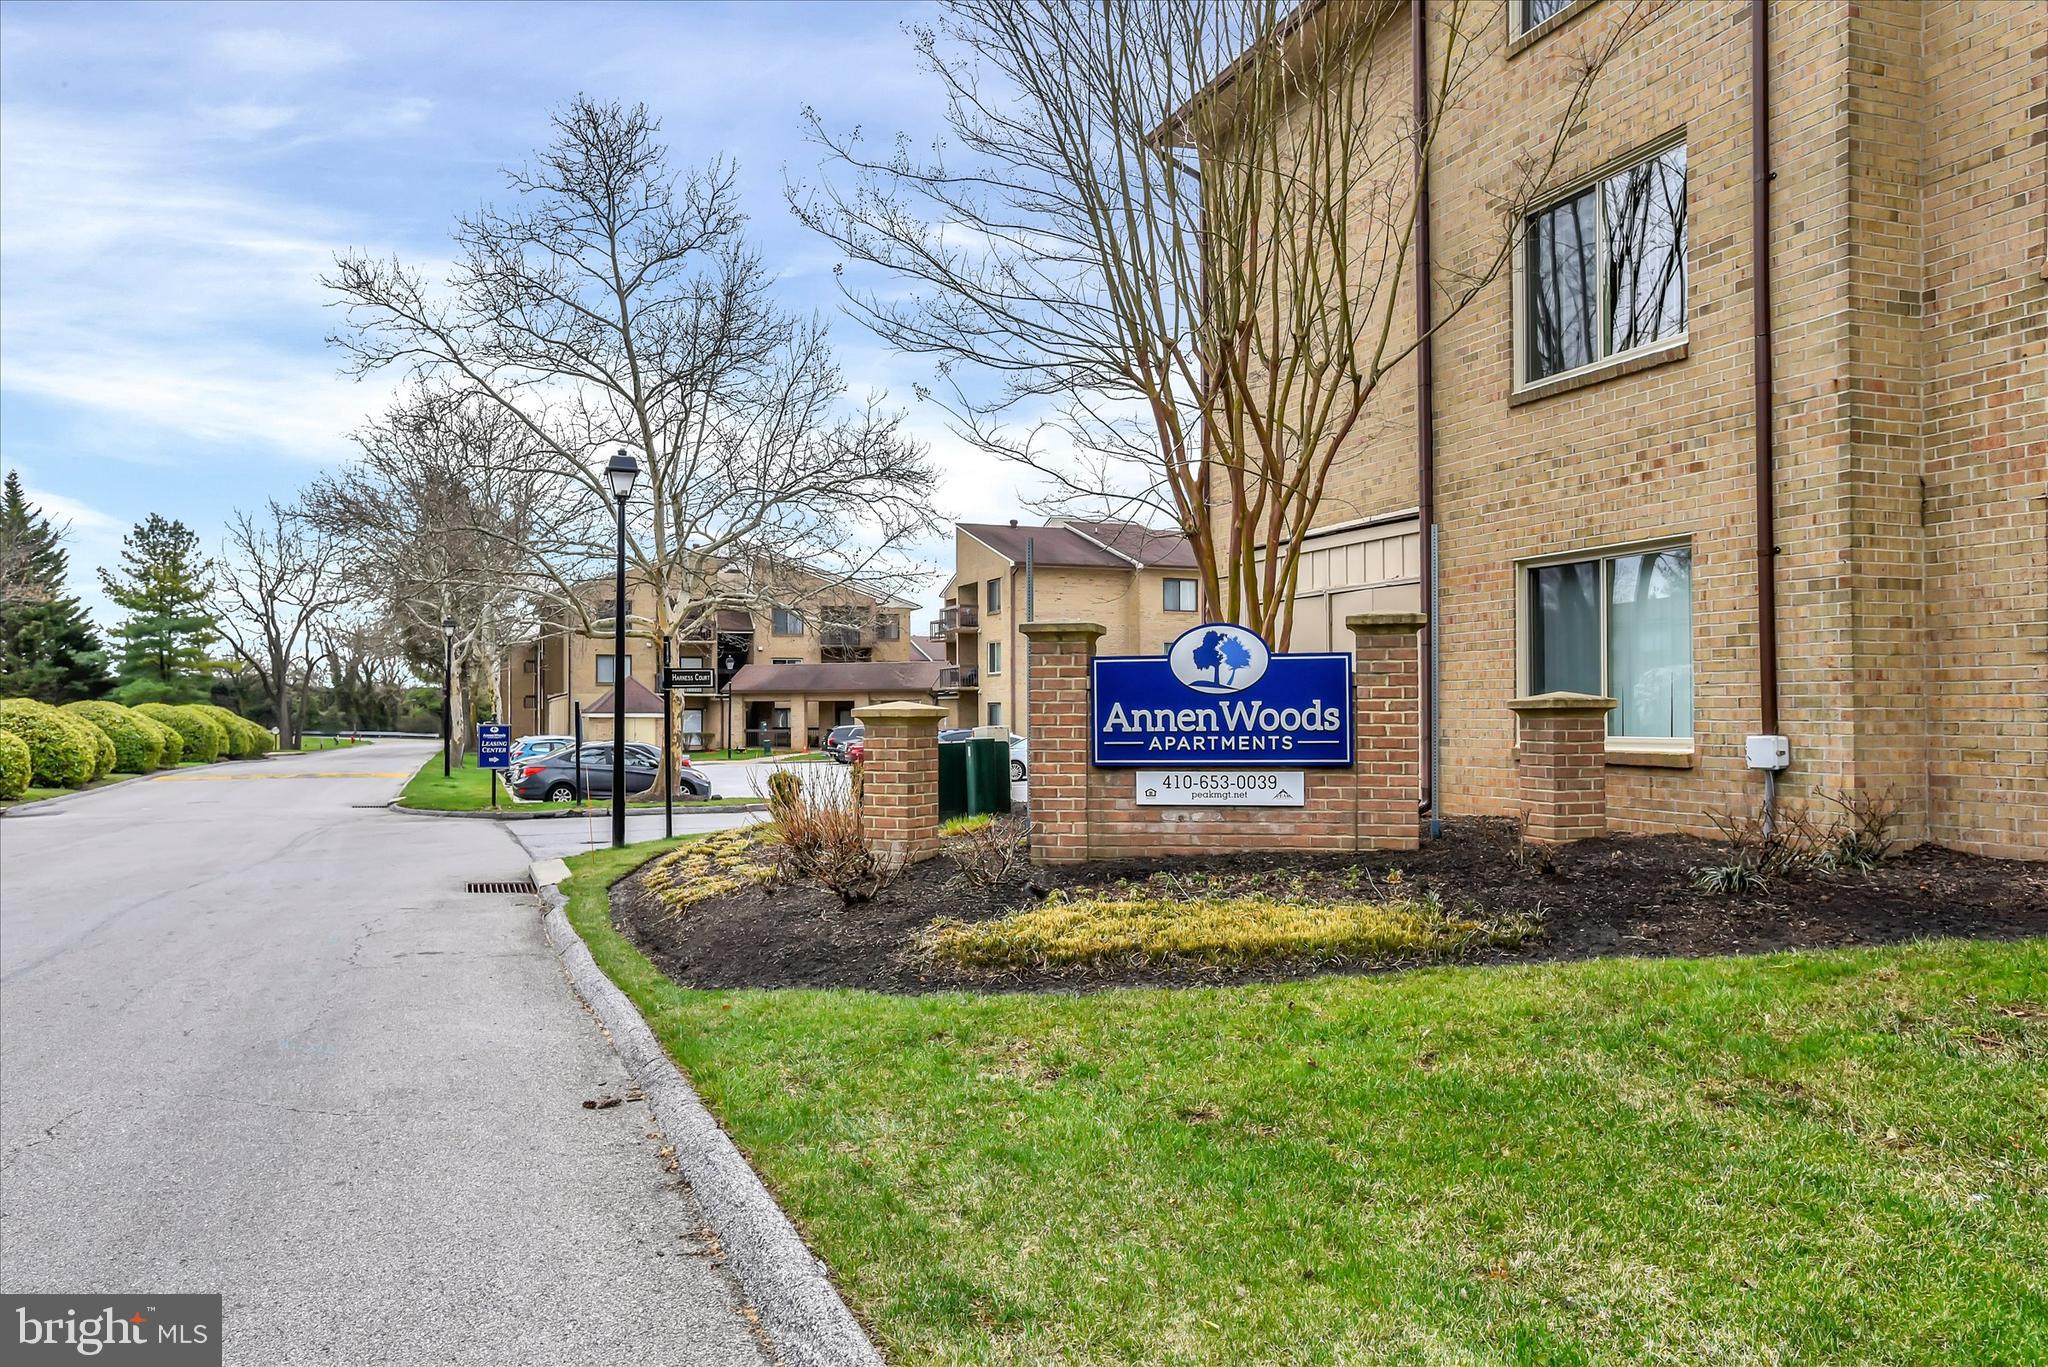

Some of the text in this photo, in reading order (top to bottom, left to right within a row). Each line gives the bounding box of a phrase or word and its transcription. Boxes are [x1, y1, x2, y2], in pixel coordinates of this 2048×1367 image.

[1148, 735, 1293, 750] APARTMENTS
[1162, 775, 1277, 789] 410-653-0039
[1191, 790, 1248, 800] peakmgt.net
